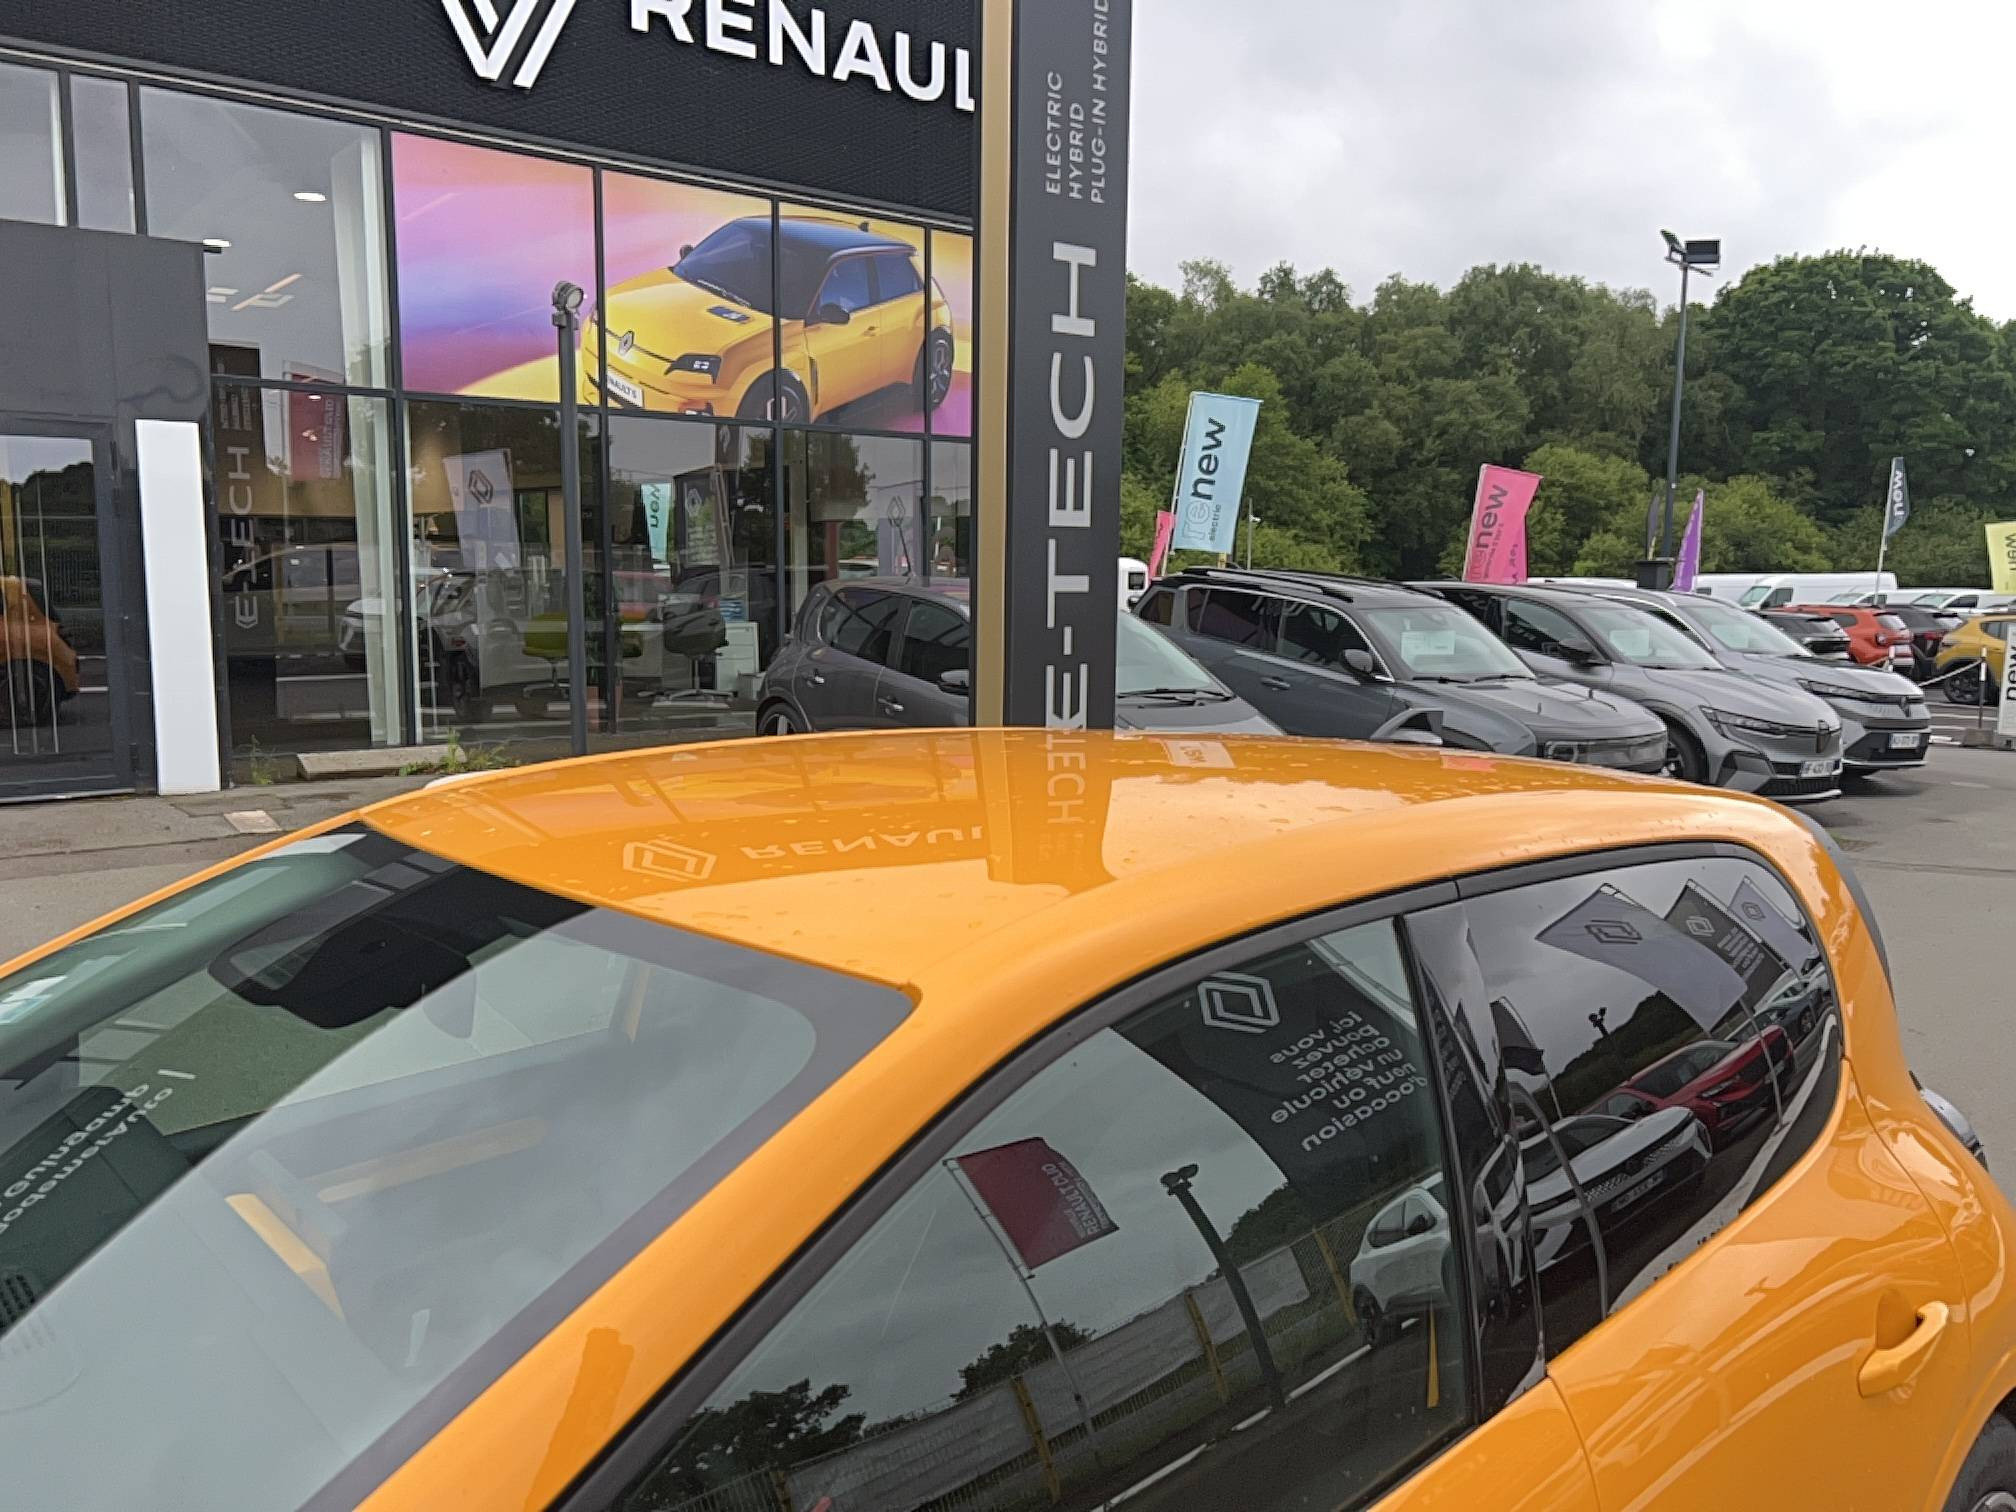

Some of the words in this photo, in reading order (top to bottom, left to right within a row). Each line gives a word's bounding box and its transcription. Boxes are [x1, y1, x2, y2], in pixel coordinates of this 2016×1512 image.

[1092, 0, 1109, 91] HYBRID
[1046, 71, 1063, 195] ELECTRIC
[1068, 102, 1084, 200] HYBRID
[1090, 98, 1107, 203] PLUG-IN
[1045, 241, 1097, 732] E-TECH
[1182, 416, 1226, 541] renew
